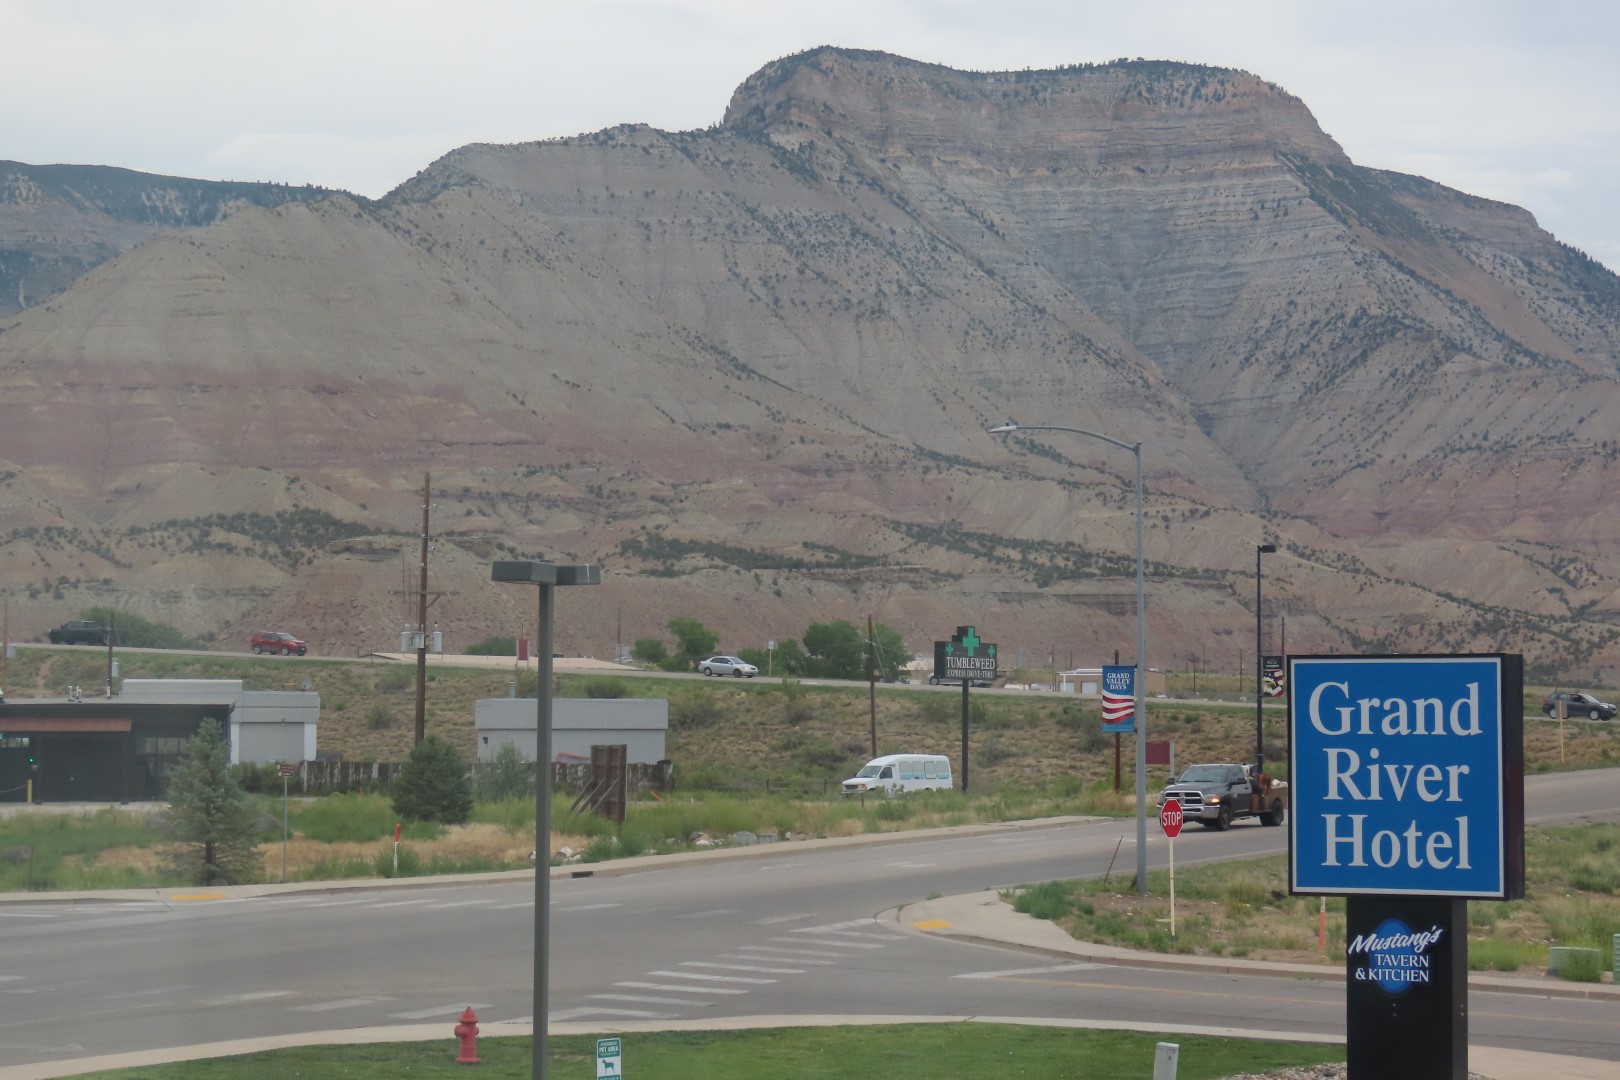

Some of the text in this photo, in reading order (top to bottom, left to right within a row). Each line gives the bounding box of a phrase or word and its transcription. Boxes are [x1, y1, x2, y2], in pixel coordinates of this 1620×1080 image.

[946, 657, 995, 669] TUMBLEWEED
[1308, 681, 1483, 736] Grand
[1322, 748, 1470, 802] River
[1162, 811, 1182, 826] STOP
[1320, 814, 1472, 869] Hotel
[1348, 925, 1443, 955] Mustang's
[1375, 954, 1429, 968] TAVERN
[1355, 968, 1429, 982] & KITCHEN
